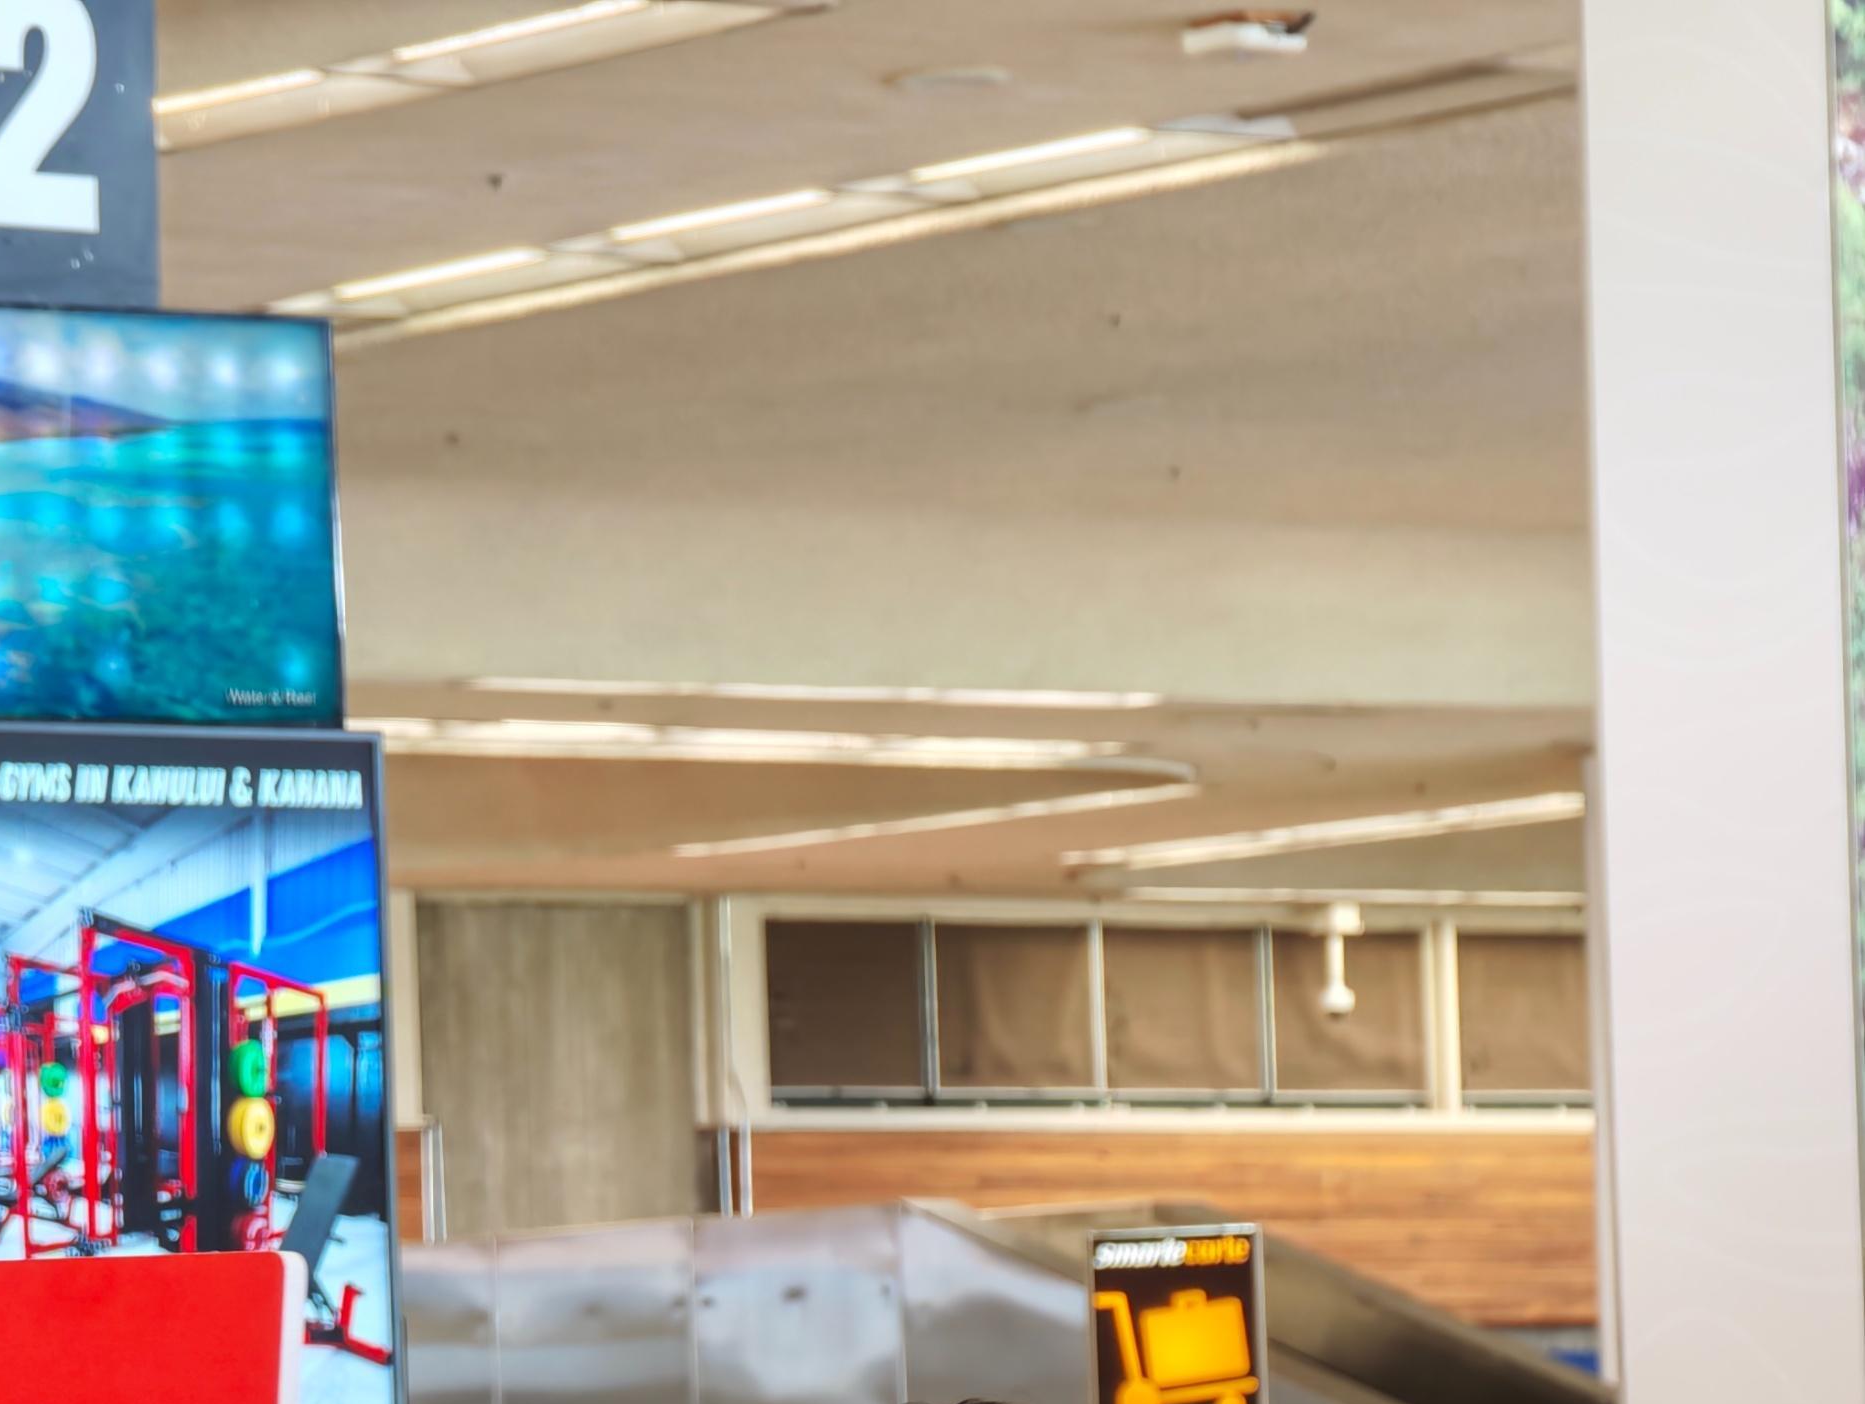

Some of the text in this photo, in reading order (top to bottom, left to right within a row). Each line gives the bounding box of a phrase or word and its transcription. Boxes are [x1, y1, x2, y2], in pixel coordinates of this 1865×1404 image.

[74, 763, 109, 804] IN
[111, 764, 227, 807] KAHULUI
[229, 766, 253, 808] &
[257, 768, 363, 809] KAHANA
